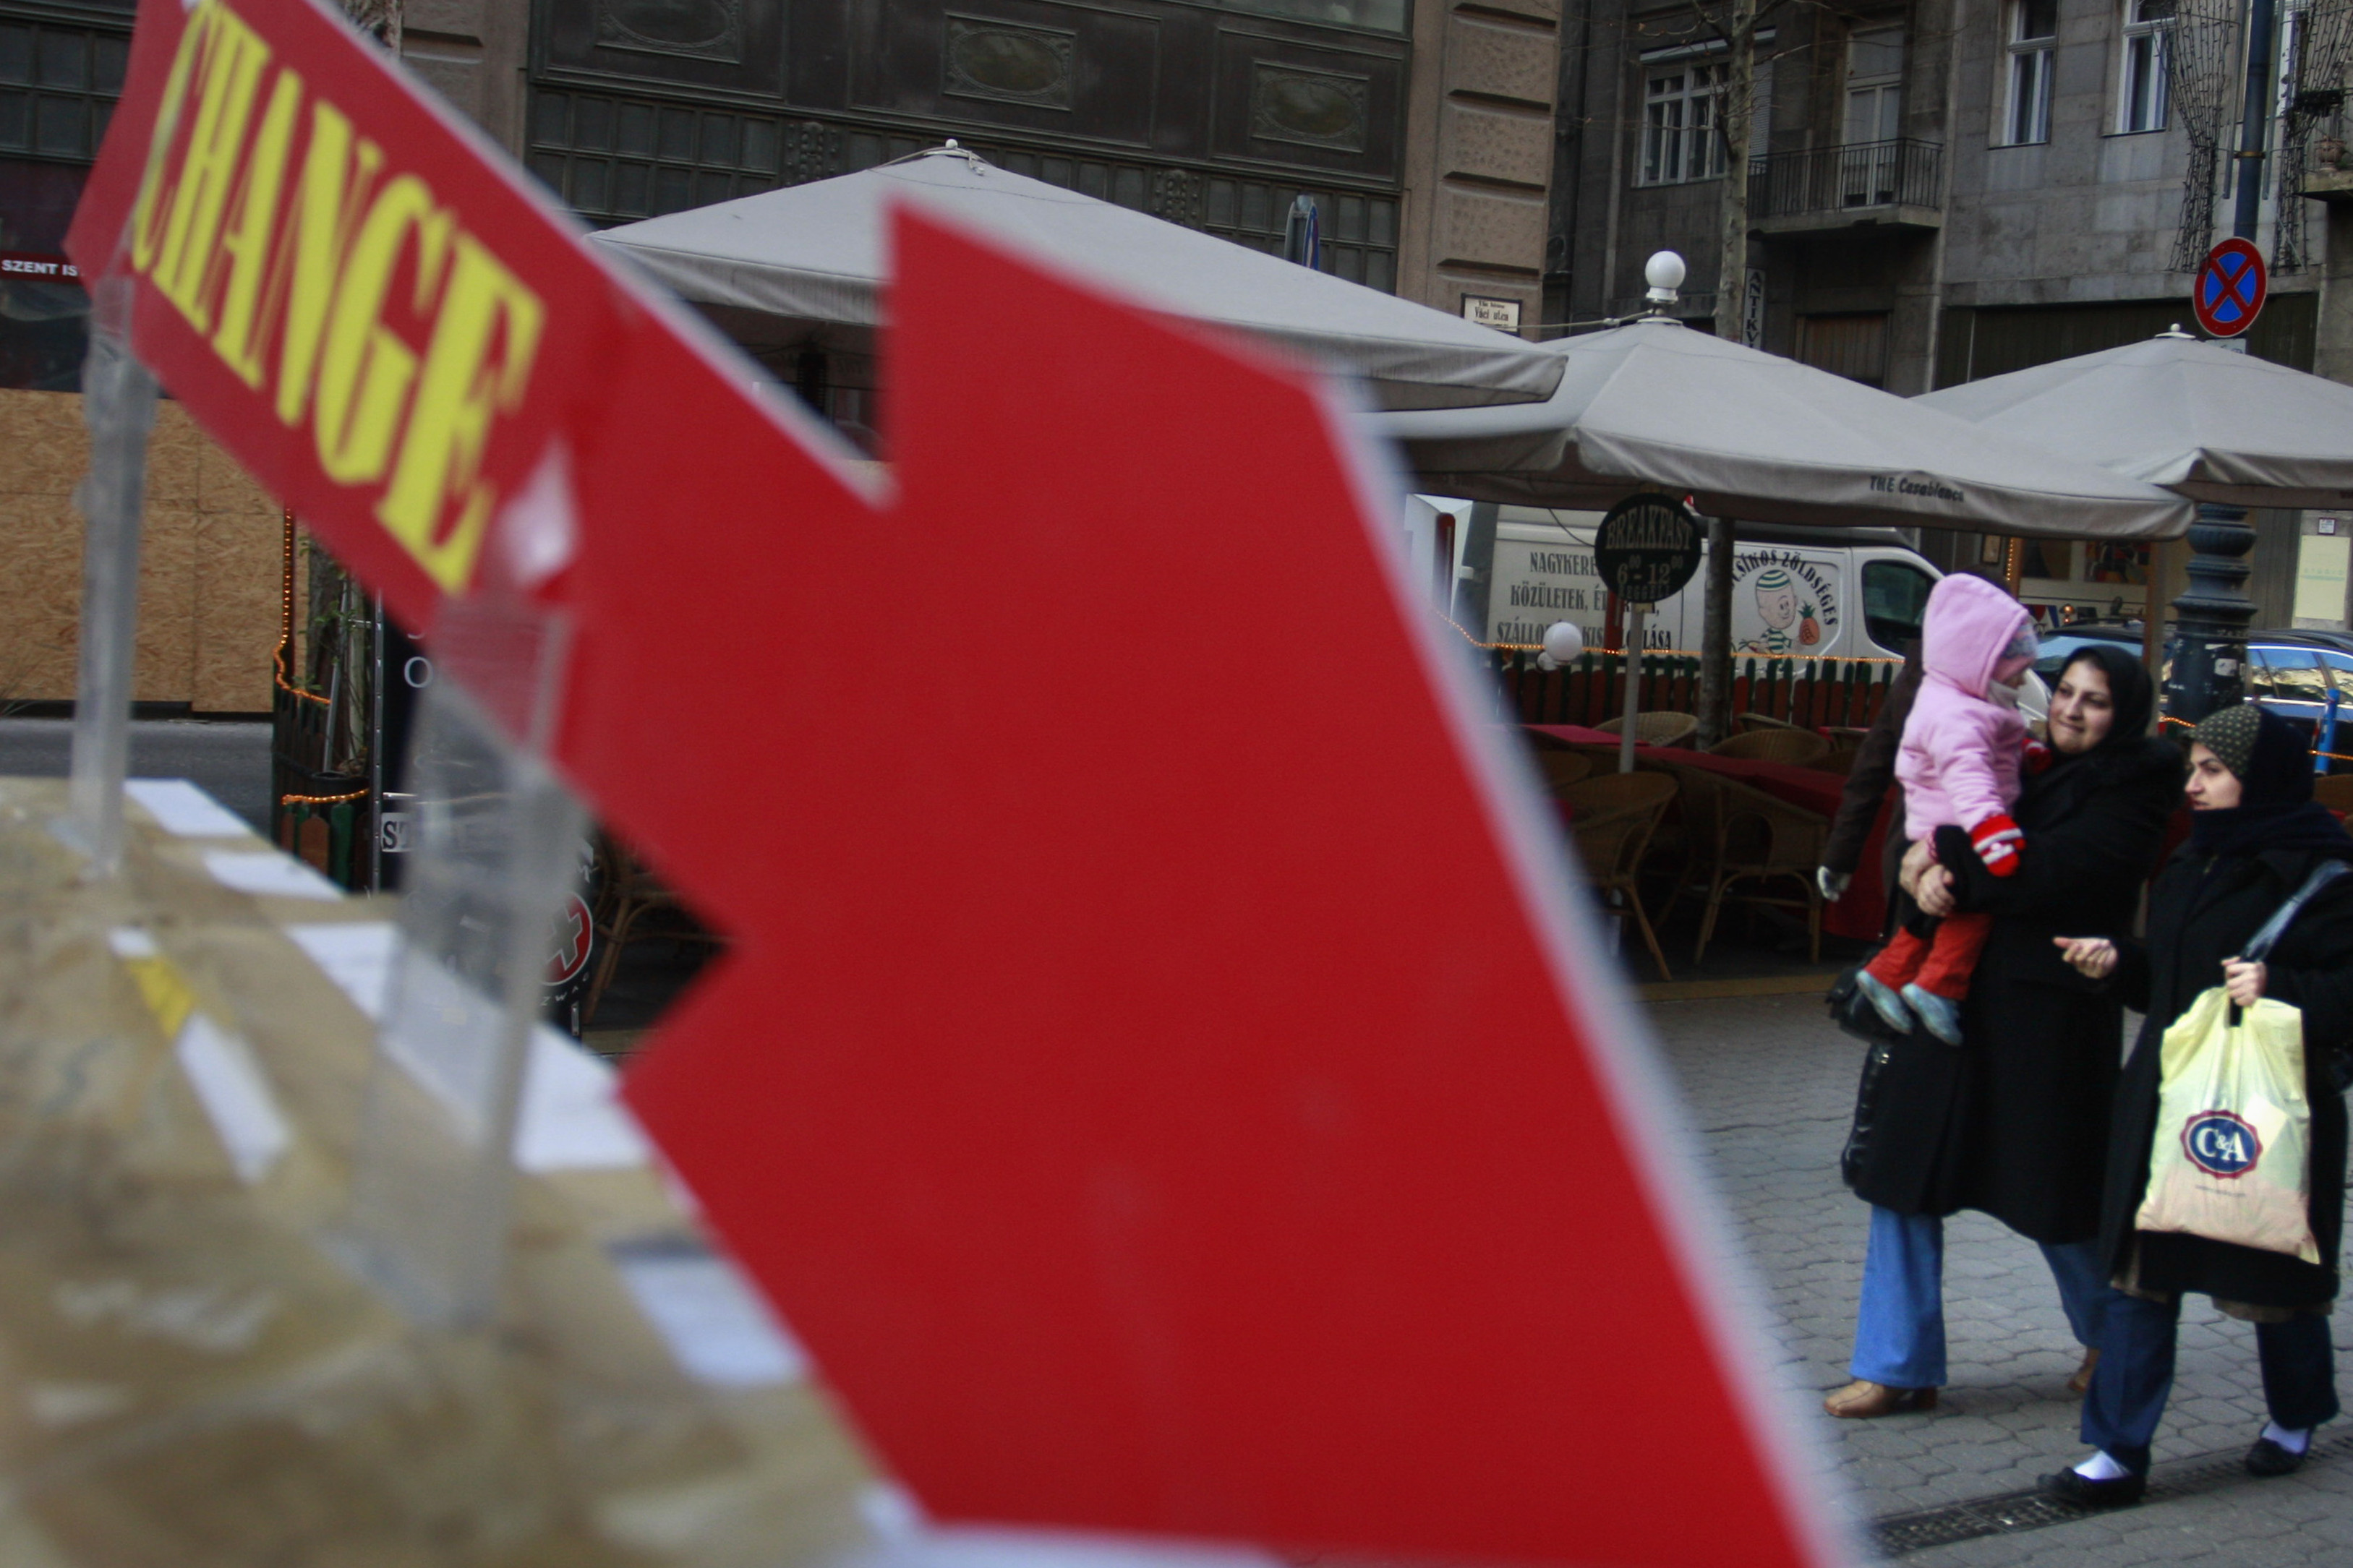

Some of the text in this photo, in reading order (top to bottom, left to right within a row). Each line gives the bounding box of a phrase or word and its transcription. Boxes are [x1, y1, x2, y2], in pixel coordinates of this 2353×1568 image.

[1, 260, 59, 275] SZENT
[132, 0, 546, 596] CHANGE
[1746, 271, 1762, 348] ANTIKV
[1870, 475, 1965, 502] THE Casablanca
[1605, 505, 1694, 550] BREAKFAST
[1510, 580, 1588, 613] KÖZÜLETEK,
[1781, 552, 1839, 626] ZÖLDSÉGES
[2194, 1127, 2249, 1162] C&A
